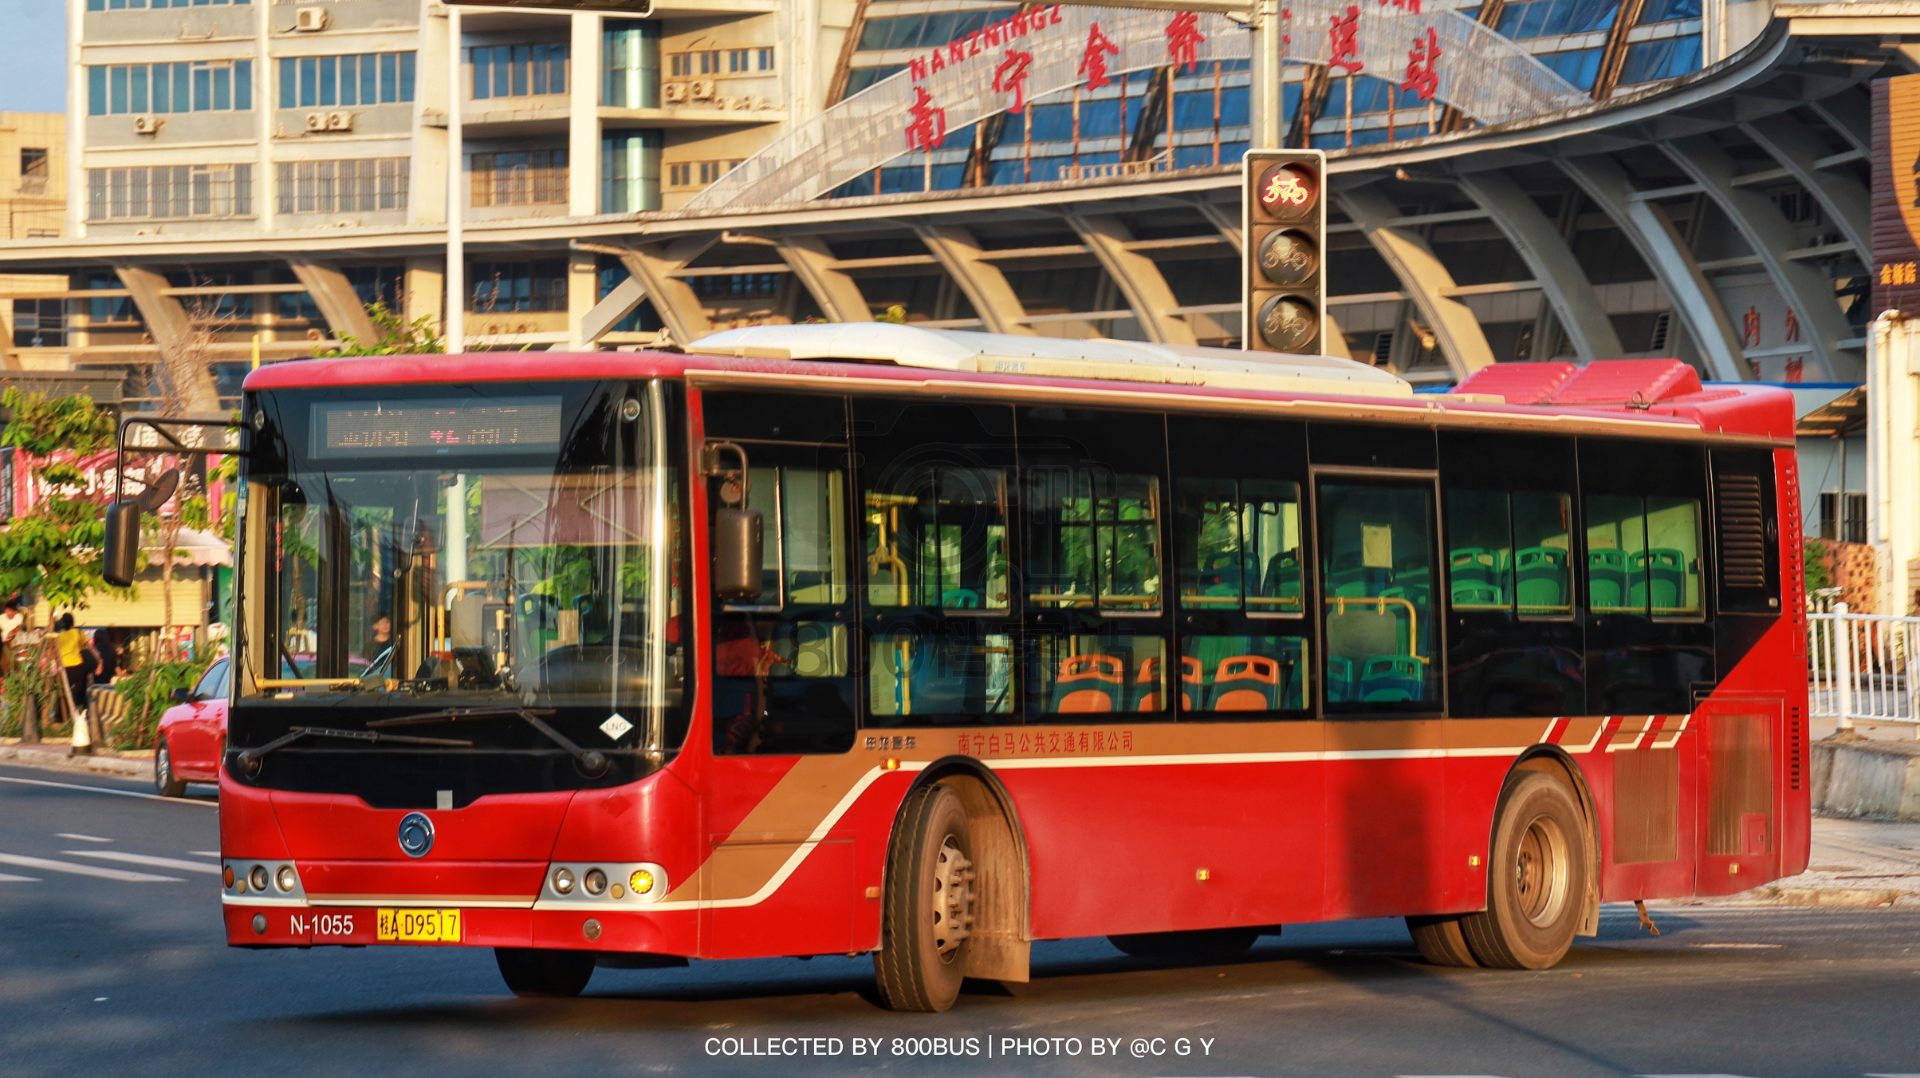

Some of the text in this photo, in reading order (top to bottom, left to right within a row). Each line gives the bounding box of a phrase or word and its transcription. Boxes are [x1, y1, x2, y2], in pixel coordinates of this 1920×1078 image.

[905, 5, 1442, 152] 南宁金桥运站
[606, 721, 627, 732] LNG
[957, 730, 1134, 756] 南宁白马公共交通有限公司
[290, 914, 354, 936] N-1055
